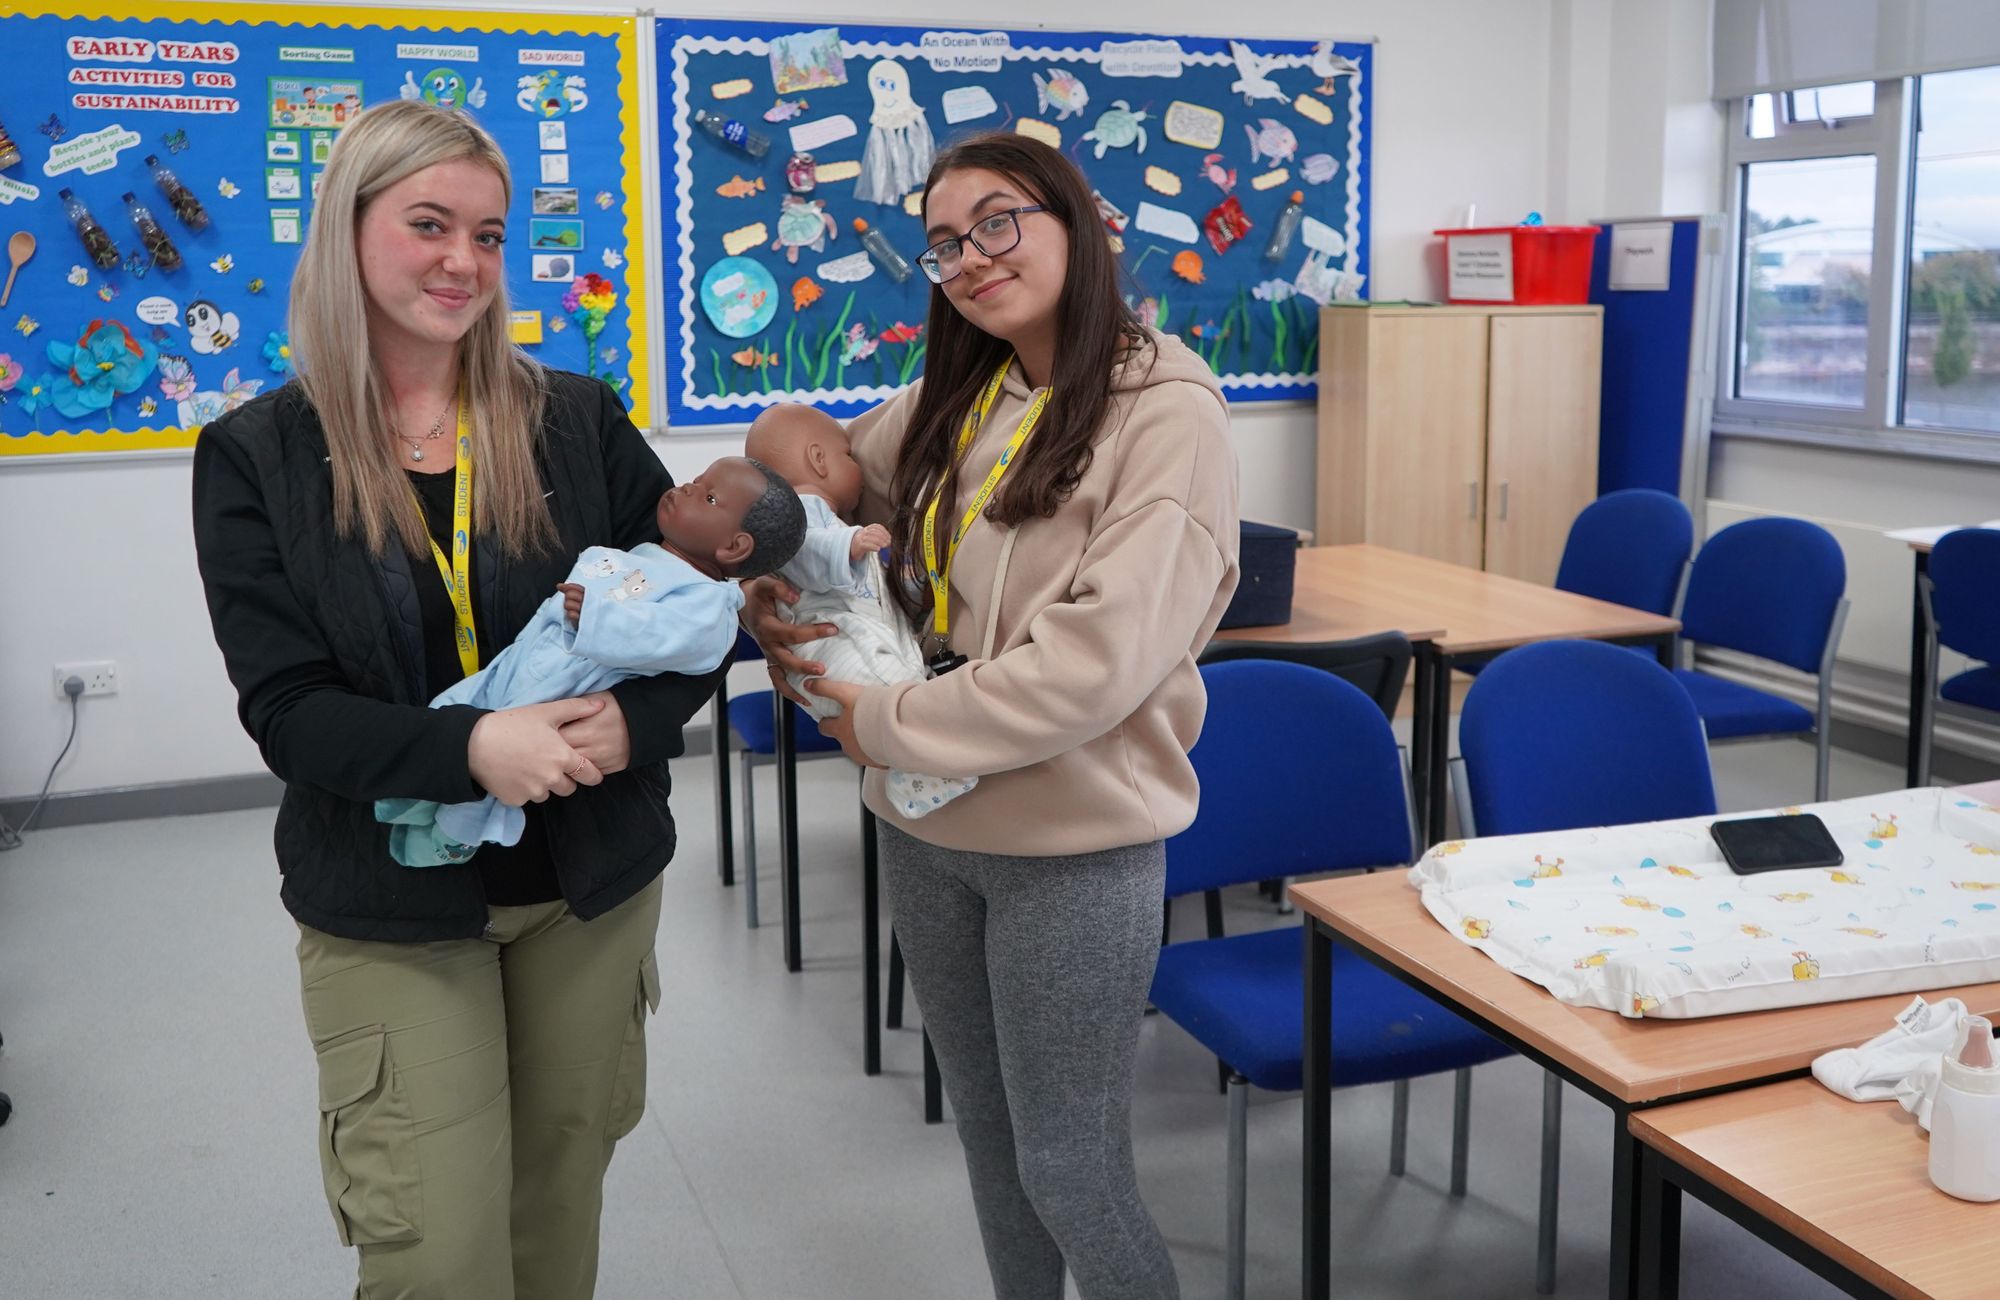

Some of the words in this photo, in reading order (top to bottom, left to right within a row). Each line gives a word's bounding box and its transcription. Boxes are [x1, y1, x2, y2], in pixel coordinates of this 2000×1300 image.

[72, 40, 149, 57] EARLY
[160, 44, 235, 61] YEARS
[924, 37, 939, 47] An
[942, 36, 977, 47] Ocean
[981, 36, 1009, 46] With
[282, 50, 320, 60] Sorting
[323, 51, 352, 59] Game
[399, 46, 434, 57] HAPPY
[437, 48, 476, 58] WORLD
[521, 52, 543, 61] SAD
[545, 52, 582, 63] WORLD
[934, 57, 951, 67] No
[954, 56, 998, 68] Motion
[71, 69, 184, 86] ACTIVITIES
[195, 74, 234, 87] FOR
[75, 95, 238, 112] SUSTAINABILITY
[54, 137, 94, 157] Recycle
[95, 127, 120, 143] your
[48, 154, 86, 172] bottles
[87, 144, 107, 158] and
[108, 135, 137, 151] plant
[85, 157, 114, 173] seeds
[3, 180, 36, 197] music
[1021, 396, 1046, 436] STUDENT
[458, 472, 469, 517] STUDENT
[971, 475, 997, 514] STUDENT
[925, 516, 934, 558] STUDENT
[456, 570, 469, 615] STUDENT
